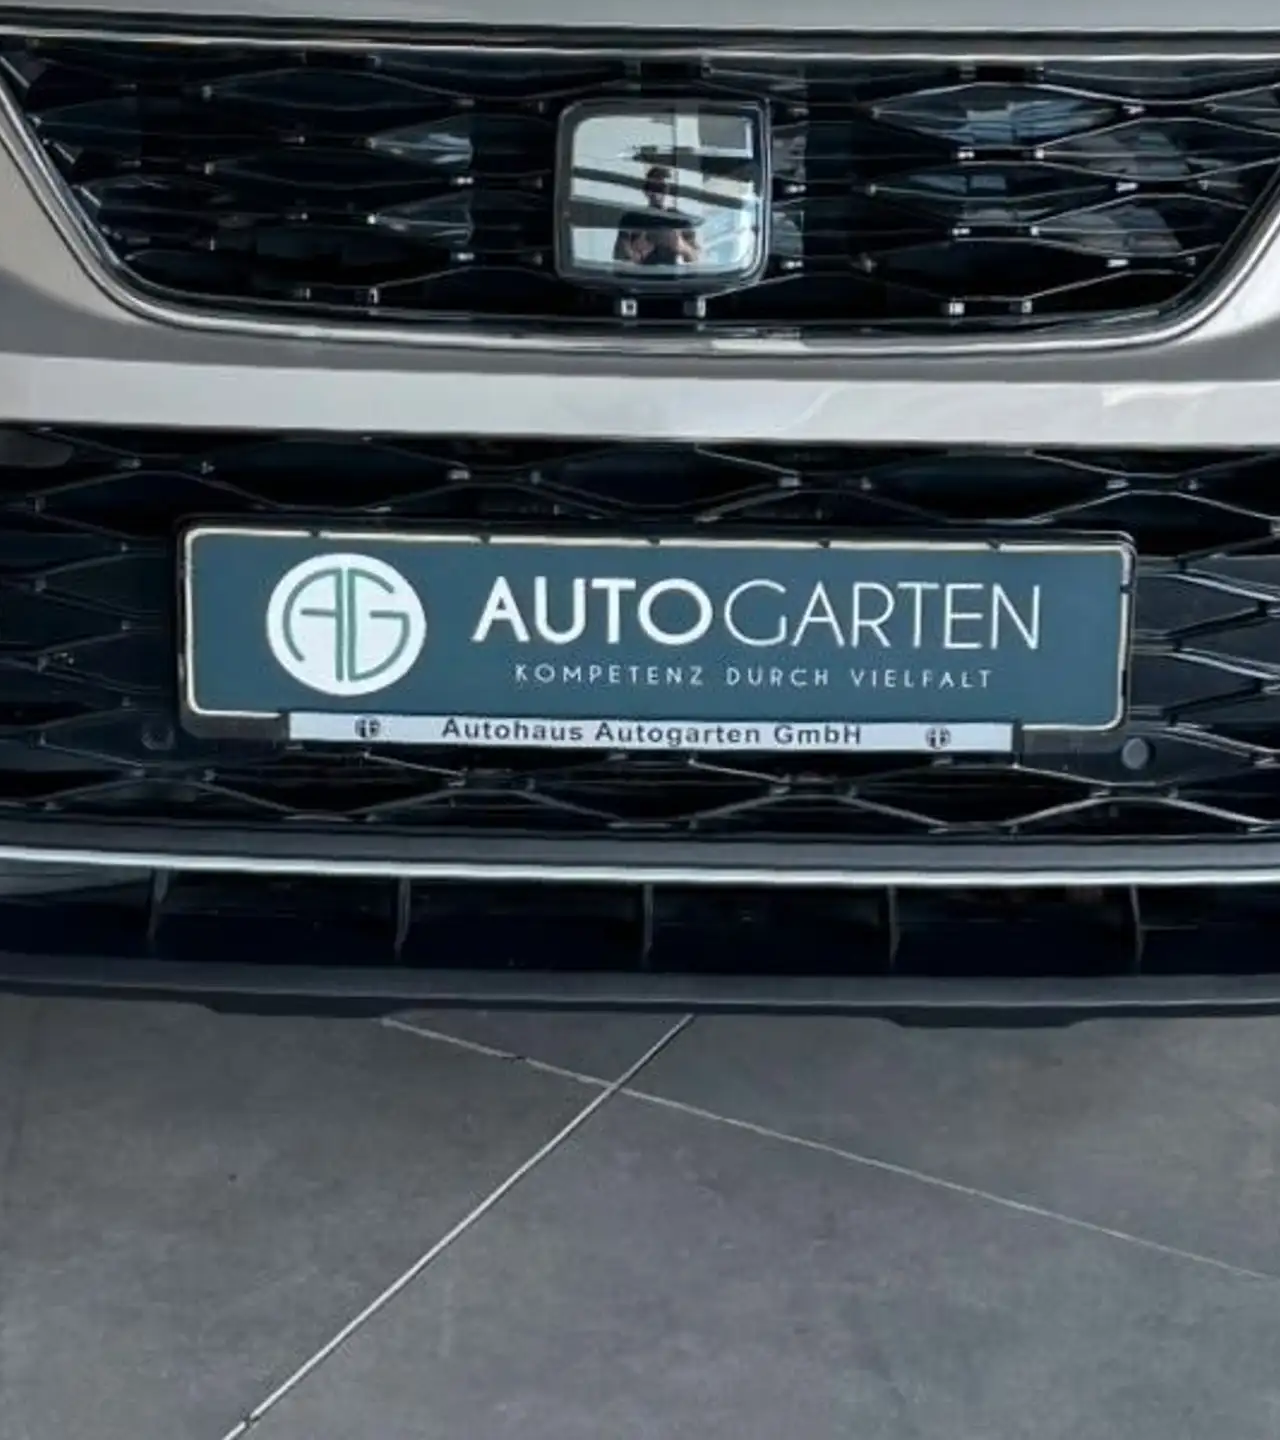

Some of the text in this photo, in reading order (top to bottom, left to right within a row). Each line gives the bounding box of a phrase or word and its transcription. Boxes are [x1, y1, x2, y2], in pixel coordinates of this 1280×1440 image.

[472, 575, 1040, 650] AUTOGARTEN
[515, 663, 993, 689] KOMPETENZ DURCH VIELFALT
[441, 717, 862, 748] Autohaus Autogarten GmbH
